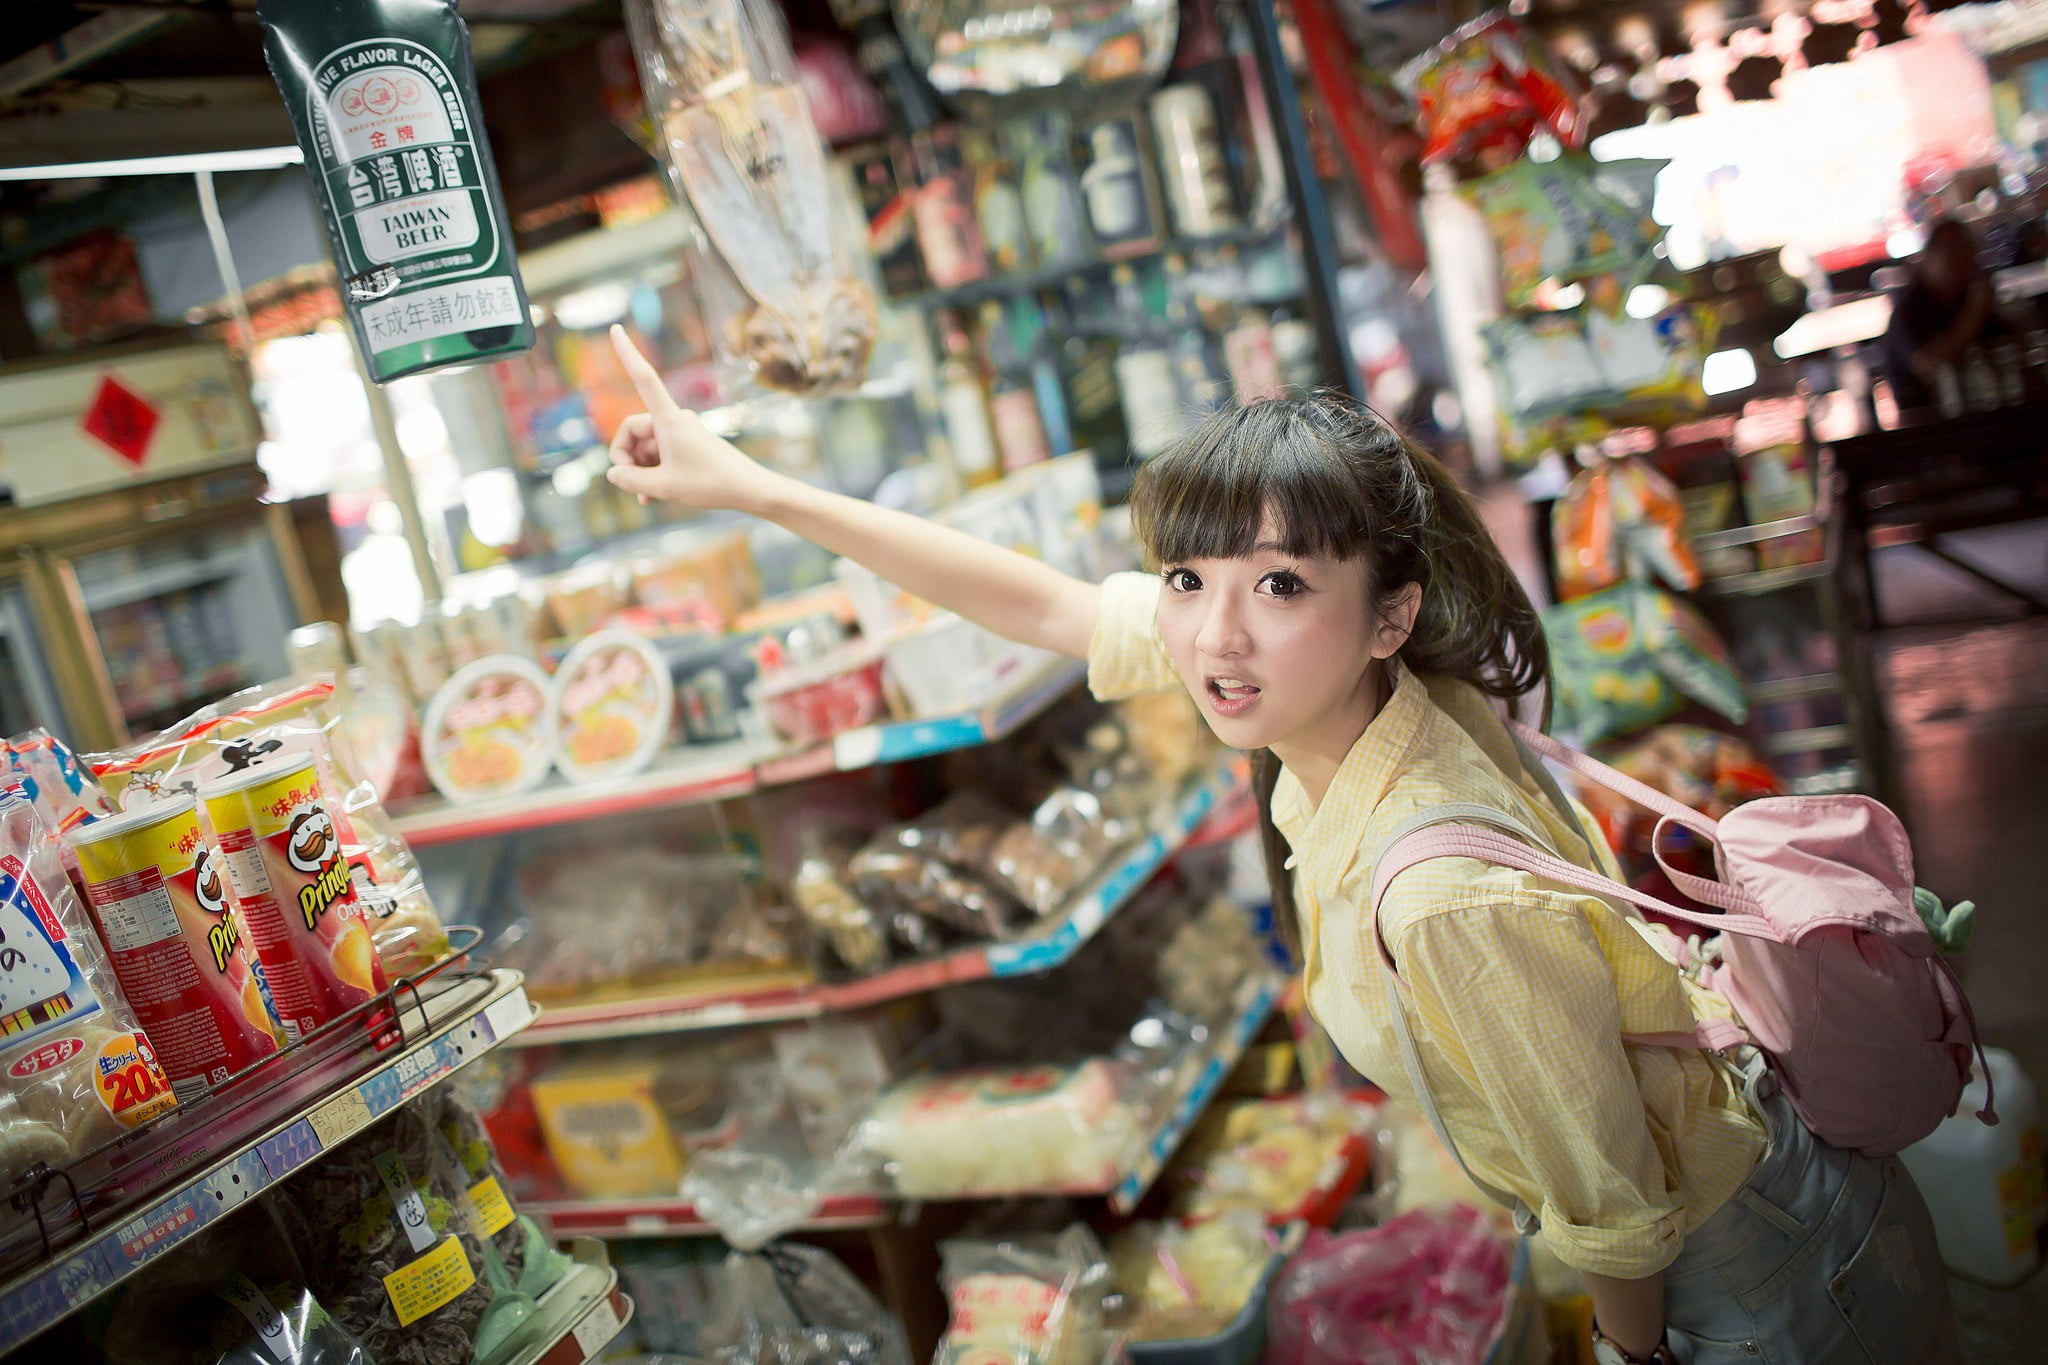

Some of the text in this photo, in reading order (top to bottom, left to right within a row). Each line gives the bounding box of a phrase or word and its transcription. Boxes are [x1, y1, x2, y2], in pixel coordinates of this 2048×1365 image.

[313, 65, 341, 159] DISTINCIVE
[340, 48, 399, 73] FLAVOR
[403, 50, 448, 89] LAGER
[442, 91, 465, 131] BEER
[368, 125, 415, 149] 金牌
[381, 206, 450, 233] TAIWAN
[395, 224, 447, 249] BEER
[369, 284, 514, 343] 未成年請勿飲酒
[20, 1040, 74, 1073] サラダ
[99, 1051, 139, 1076] 生クリーム
[148, 1200, 191, 1228] GREEN TIME
